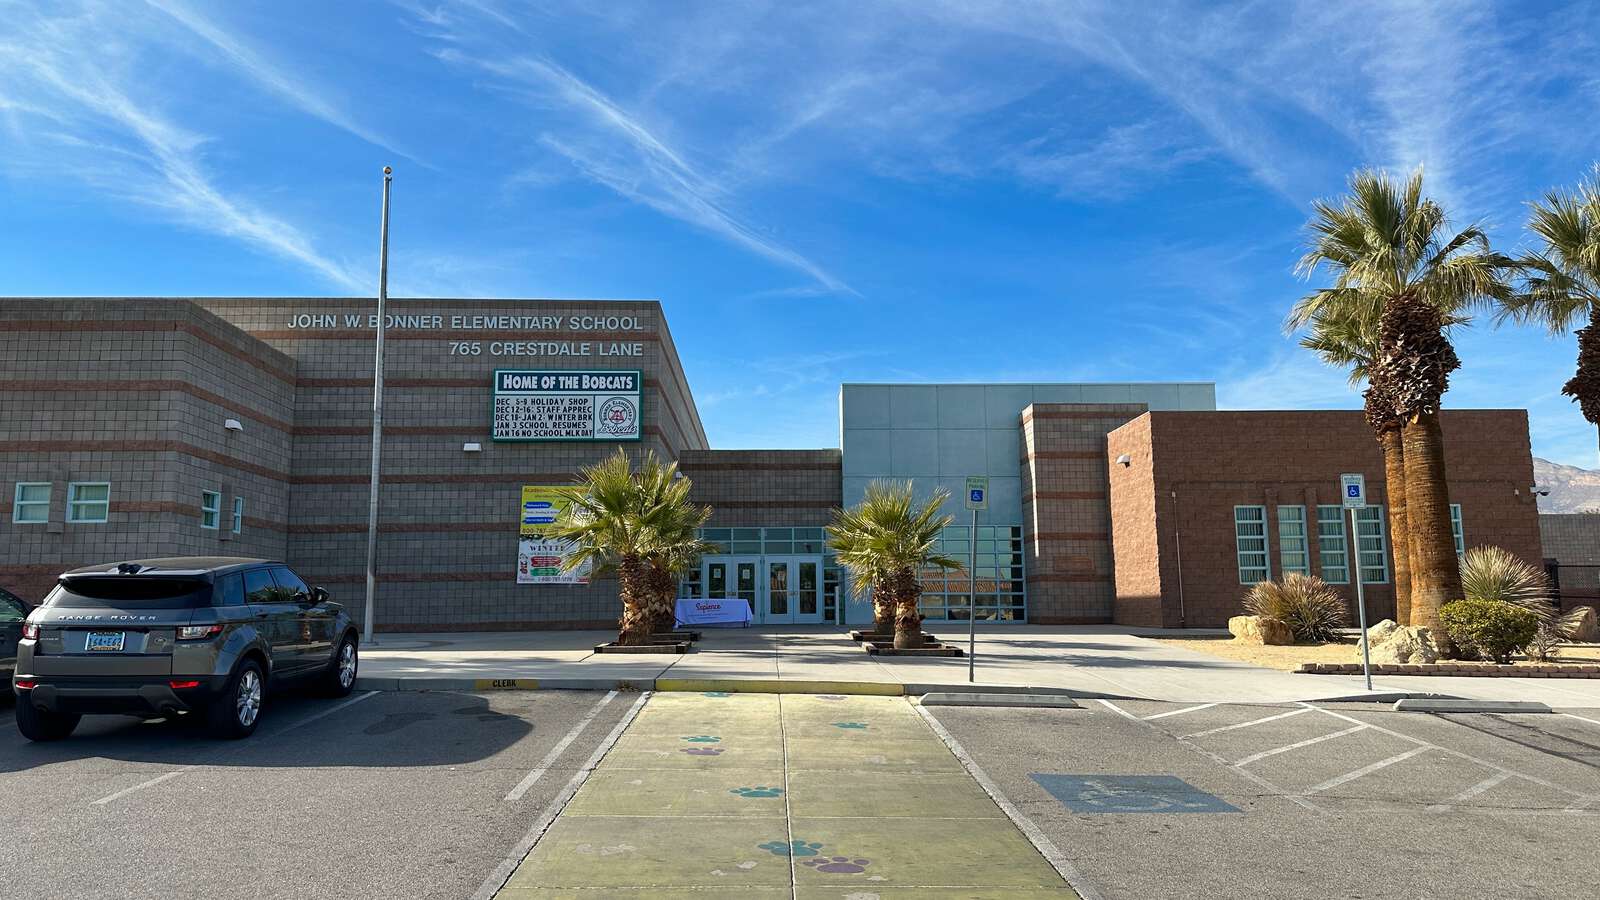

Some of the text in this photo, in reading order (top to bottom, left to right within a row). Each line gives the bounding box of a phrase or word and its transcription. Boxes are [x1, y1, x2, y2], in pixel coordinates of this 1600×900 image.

[287, 314, 337, 328] JOHN
[344, 315, 362, 328] W.
[451, 316, 563, 329] ELEMENTARY
[569, 316, 643, 330] SCHOOL
[449, 342, 643, 356] 765 CRESTDALE LANE
[503, 374, 633, 389] HOME OF THE BOBCATS
[492, 679, 516, 687] CLERK
